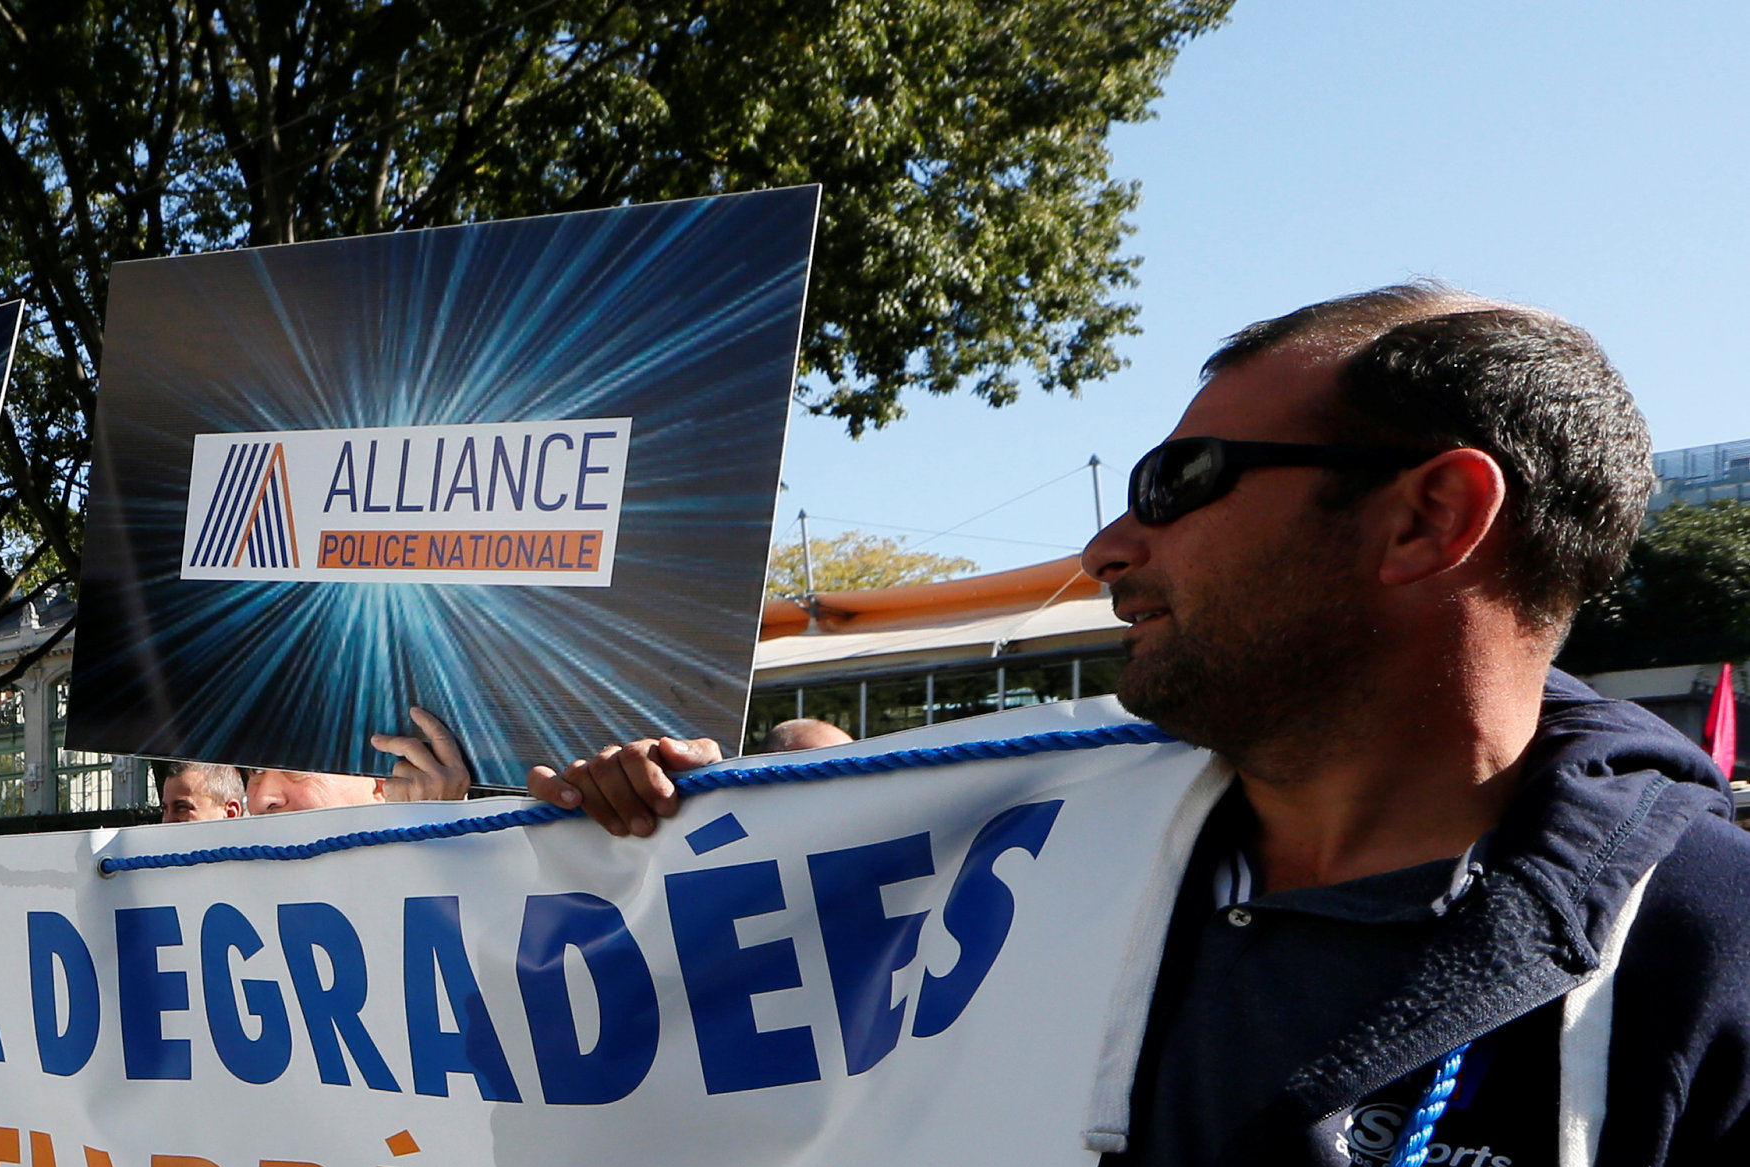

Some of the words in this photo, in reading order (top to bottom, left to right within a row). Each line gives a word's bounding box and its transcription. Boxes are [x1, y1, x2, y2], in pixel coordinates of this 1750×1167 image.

[323, 431, 617, 512] ALLIANCE
[322, 534, 418, 567] POLICE
[427, 534, 597, 568] NATIONALE
[27, 799, 1066, 1105] DEGRADÉES
